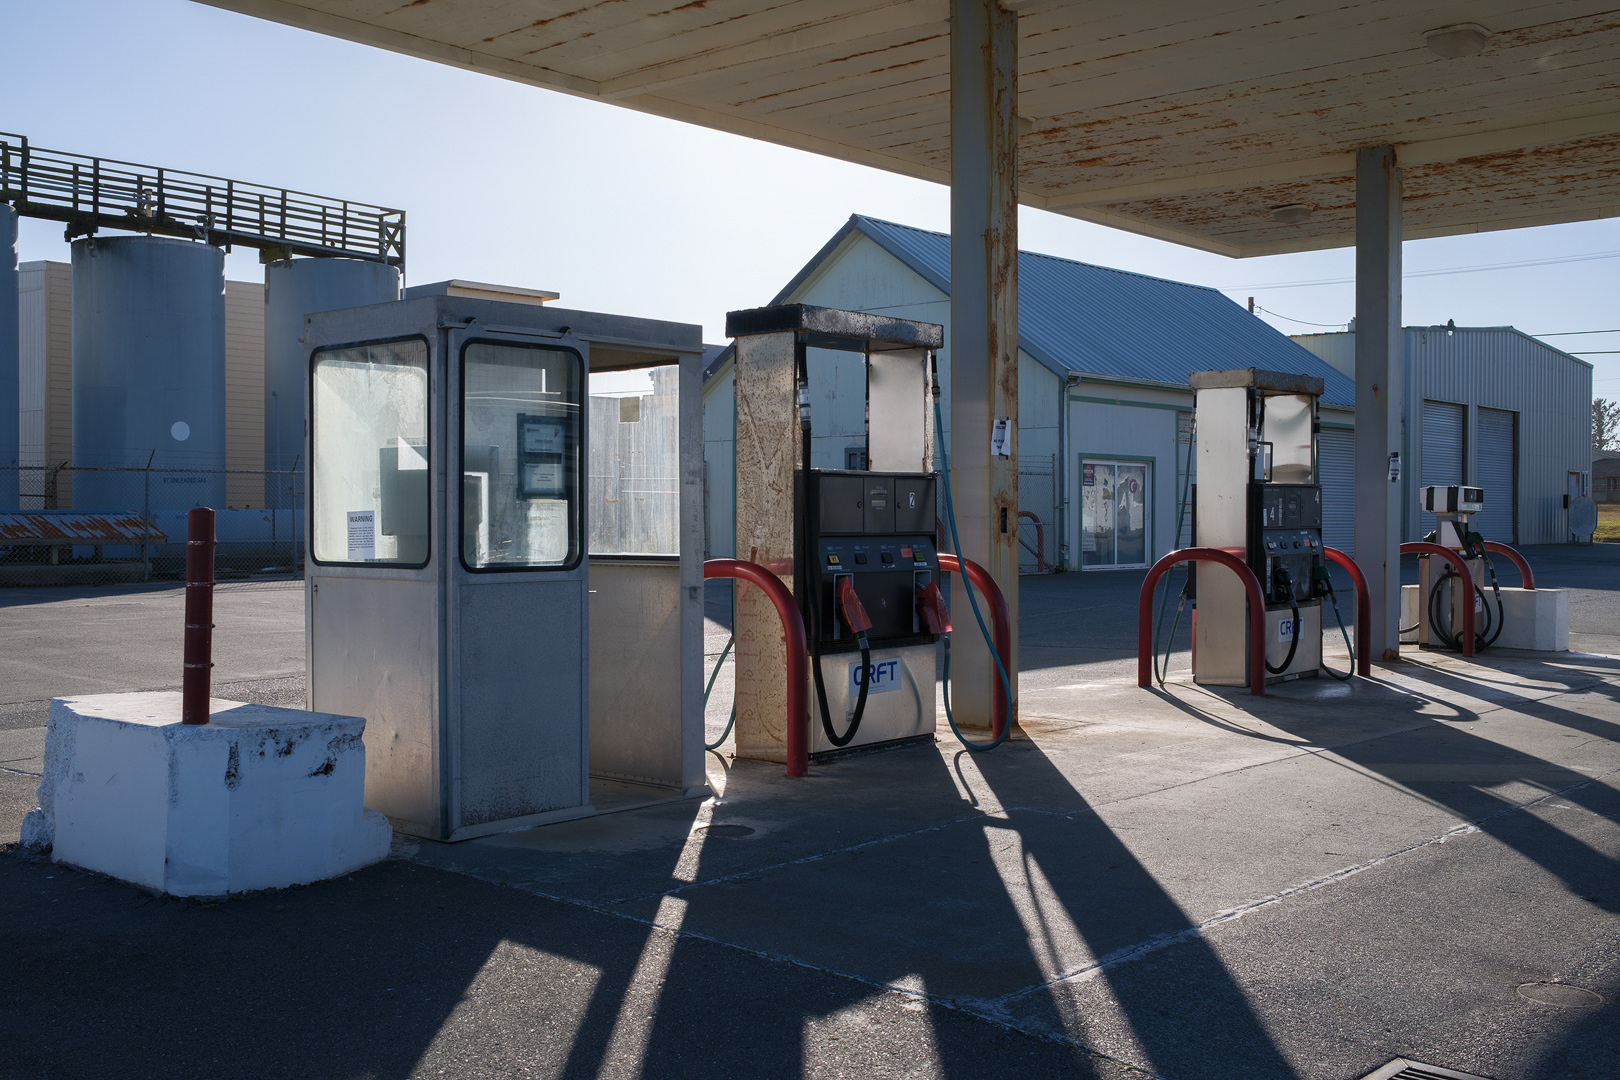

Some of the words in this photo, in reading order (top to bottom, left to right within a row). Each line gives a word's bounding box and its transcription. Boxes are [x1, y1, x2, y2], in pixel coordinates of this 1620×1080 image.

[909, 493, 915, 508] 2
[1315, 490, 1320, 504] 4
[349, 515, 373, 523] WARNING
[1270, 506, 1275, 521] 4
